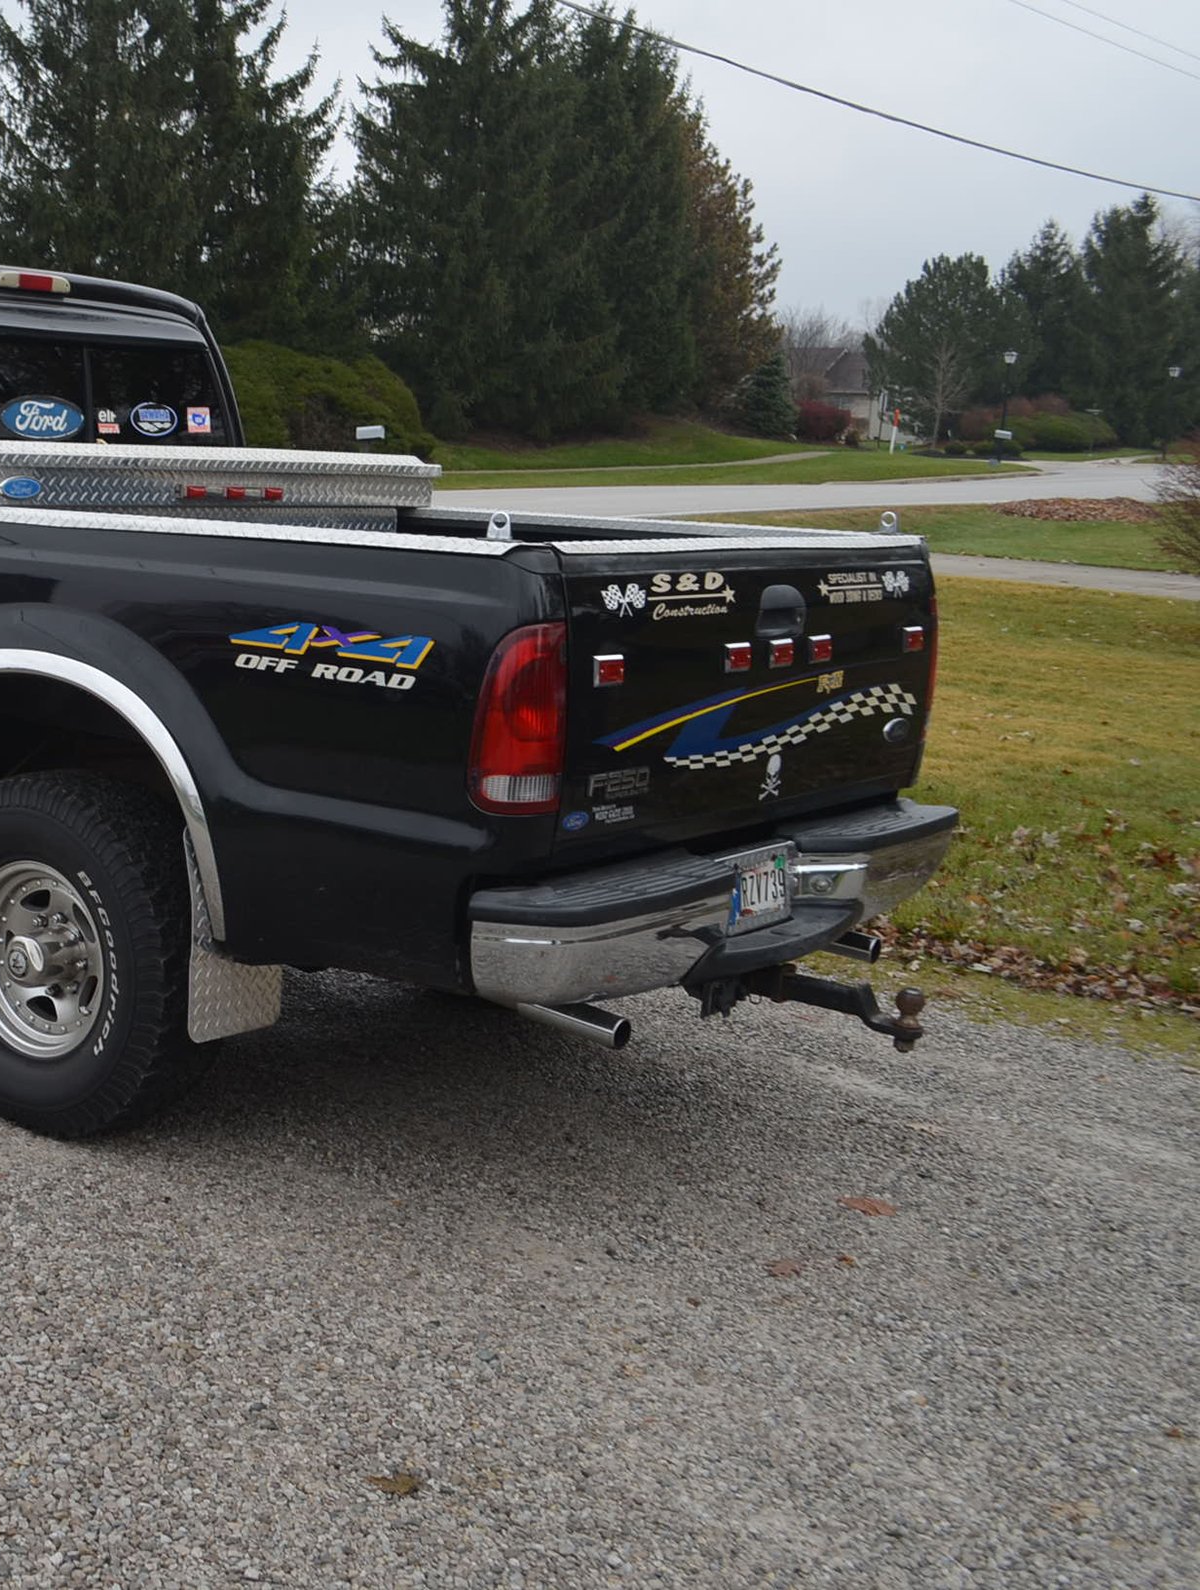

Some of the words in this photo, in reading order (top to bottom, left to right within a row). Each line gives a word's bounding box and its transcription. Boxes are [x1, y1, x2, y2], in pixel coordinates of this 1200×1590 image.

[15, 400, 68, 432] Ford
[827, 572, 868, 584] SPECIALIST
[652, 602, 728, 620] Construction
[235, 653, 298, 674] OFF
[311, 662, 417, 691] ROAD
